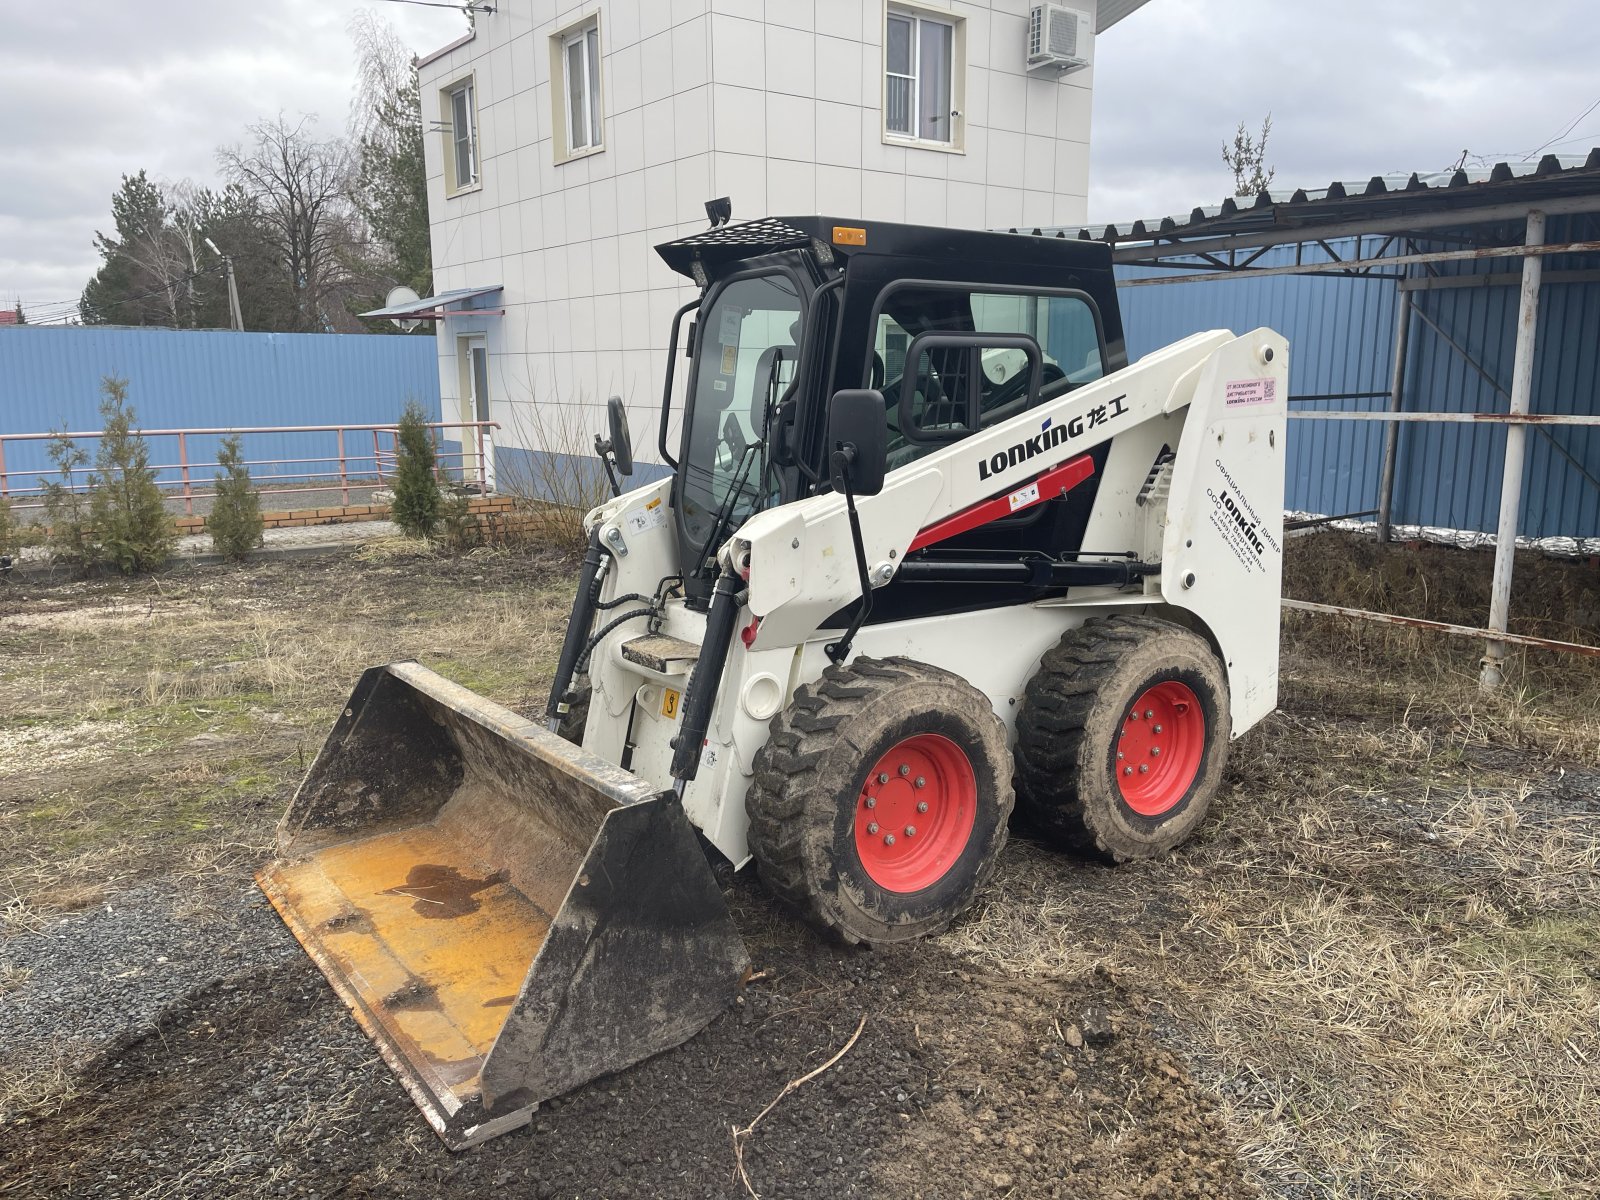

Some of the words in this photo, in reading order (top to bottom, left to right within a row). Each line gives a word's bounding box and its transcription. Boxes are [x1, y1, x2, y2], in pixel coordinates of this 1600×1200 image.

[1087, 393, 1129, 429] 龙工
[978, 417, 1083, 481] LONKING
[1206, 488, 1222, 510] ООО
[1233, 525, 1266, 573] Вертикаль»
[1215, 459, 1262, 526] ОФИЦИАЛЬНЫЙ
[1261, 527, 1281, 553] ДИЛЕР
[1219, 490, 1265, 555] LONKING
